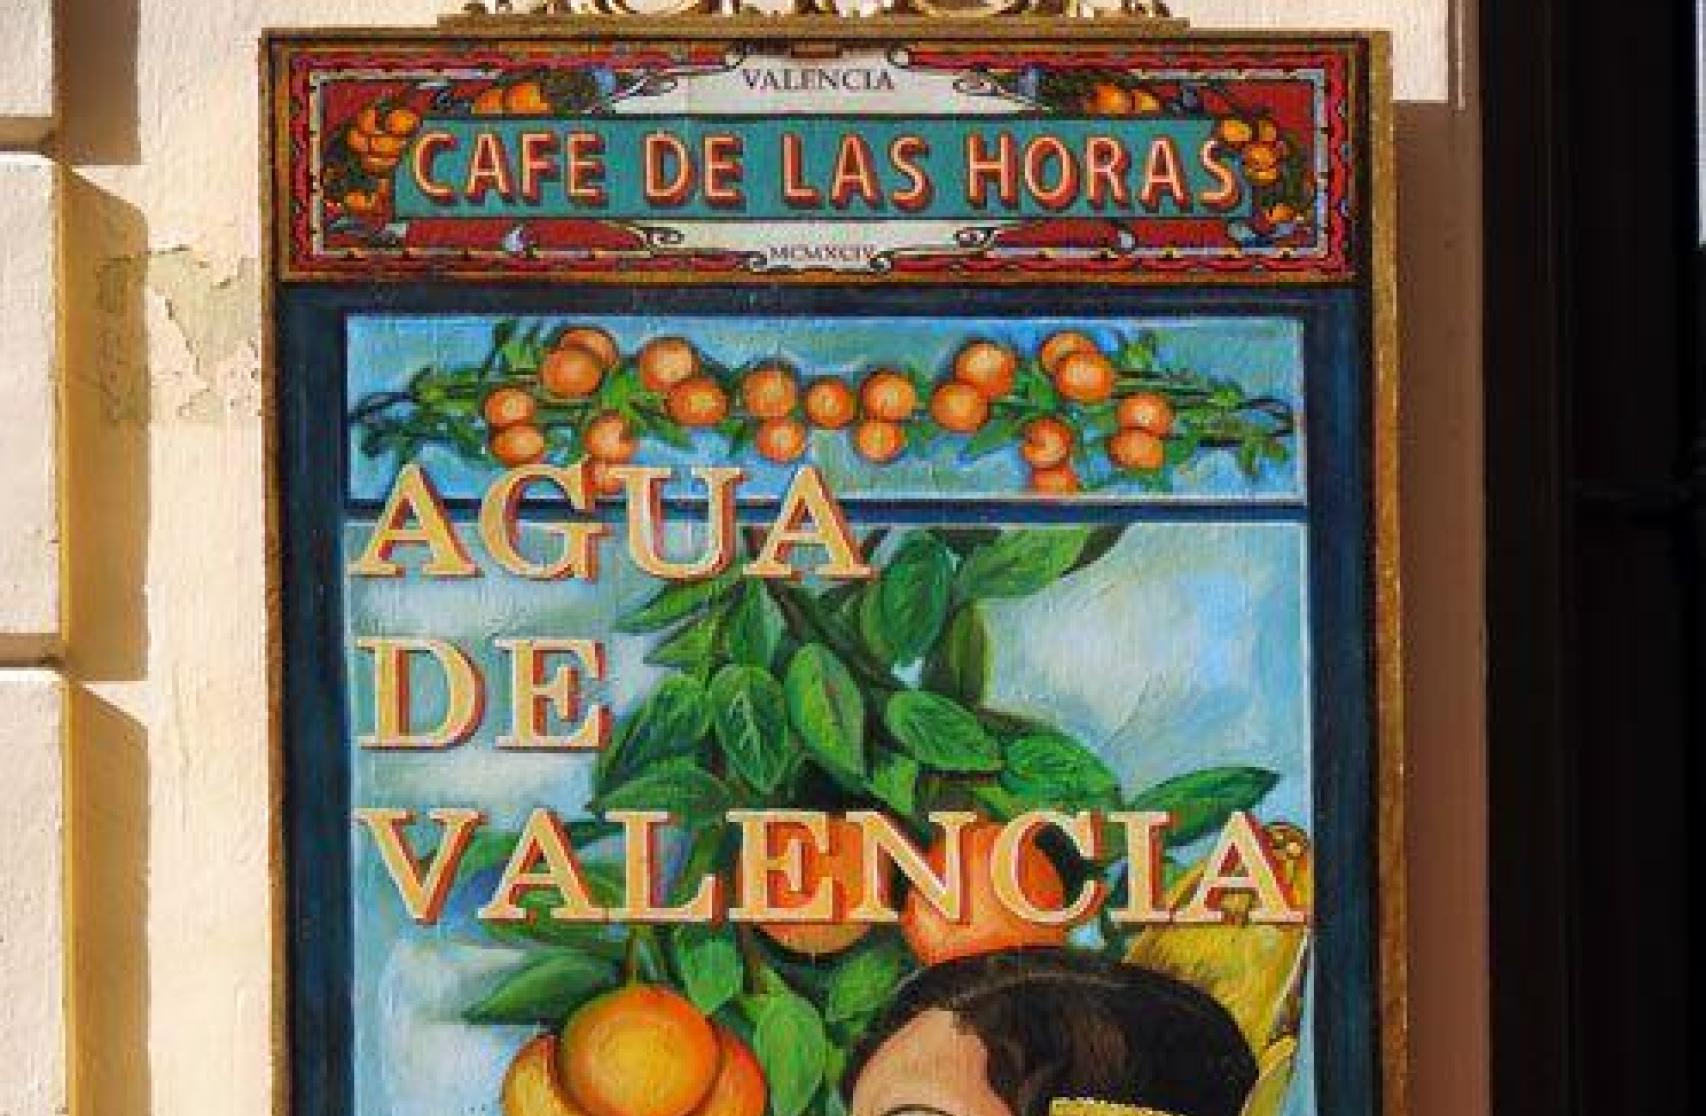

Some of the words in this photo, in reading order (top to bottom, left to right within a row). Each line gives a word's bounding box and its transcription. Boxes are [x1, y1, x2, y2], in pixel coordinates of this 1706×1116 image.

[742, 67, 895, 91] VALENCIA
[412, 132, 606, 207] CAFE
[645, 132, 745, 209] DE
[781, 134, 930, 210] LAS
[967, 134, 1240, 212] HORAS
[347, 463, 874, 582] AGUA
[357, 638, 611, 751] DE
[354, 807, 1311, 927] VALENCIA
